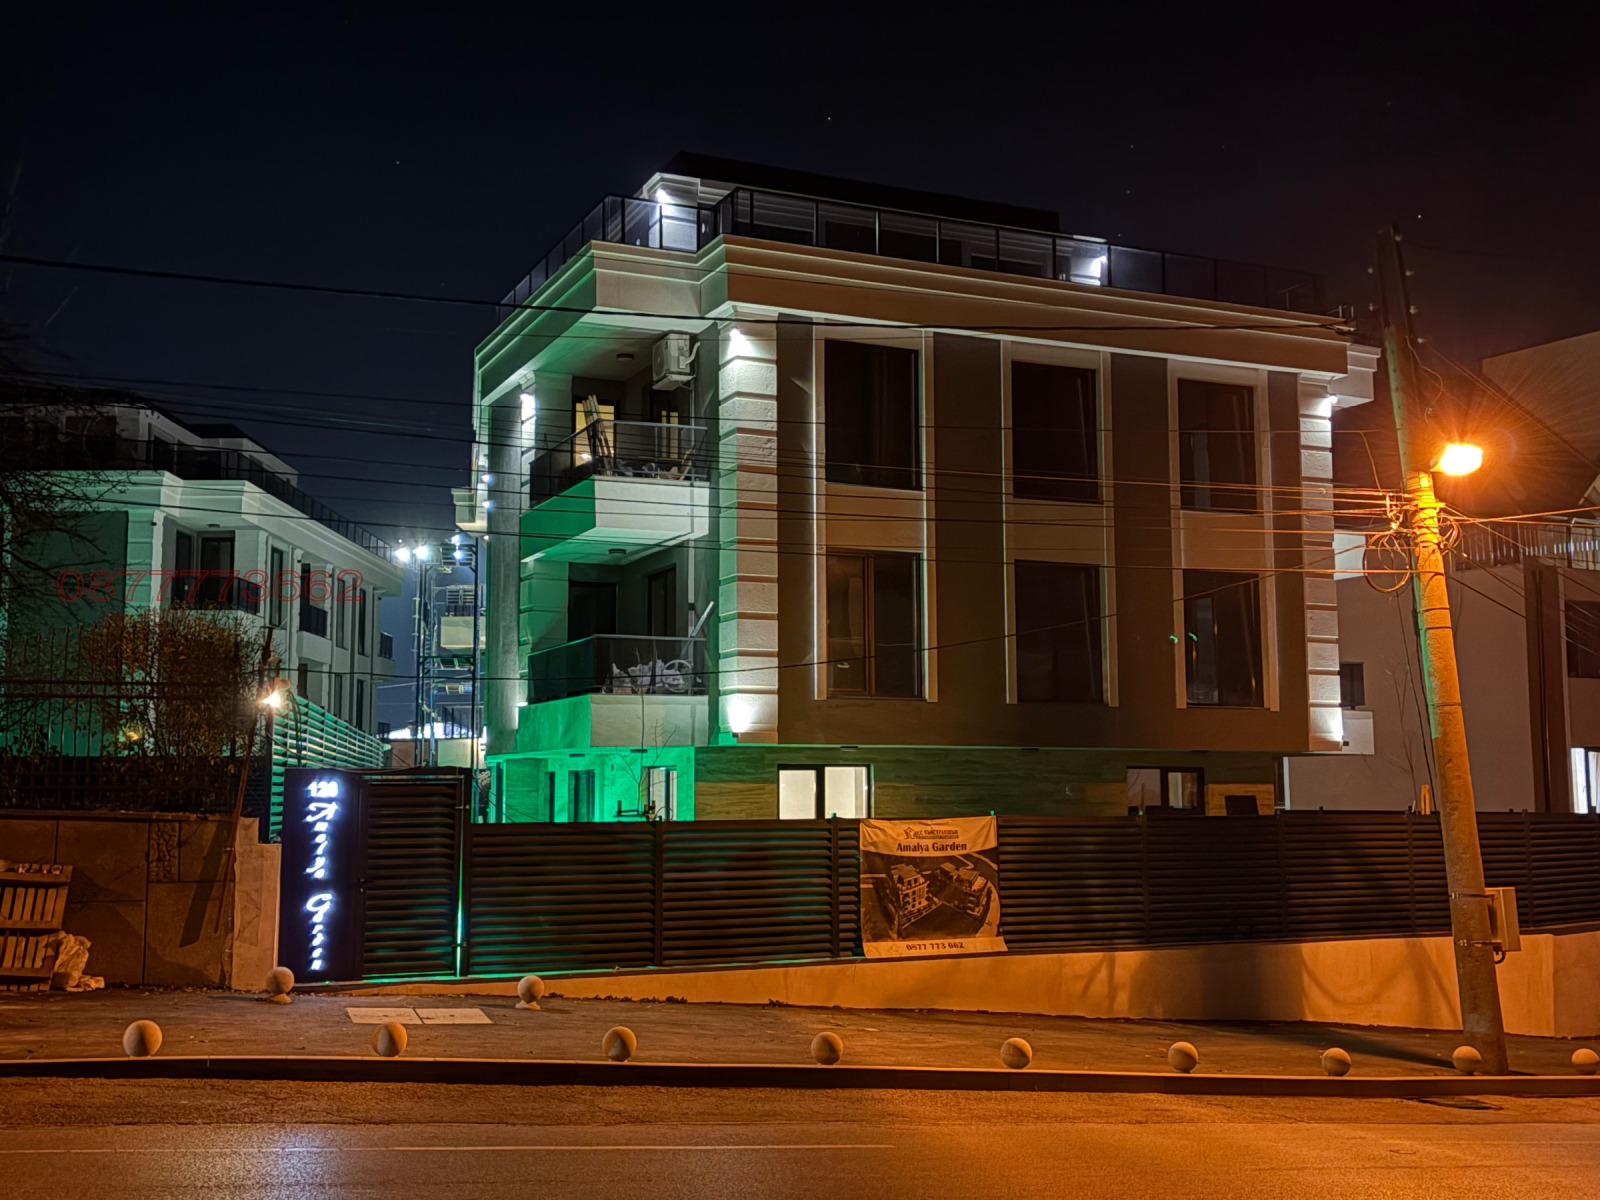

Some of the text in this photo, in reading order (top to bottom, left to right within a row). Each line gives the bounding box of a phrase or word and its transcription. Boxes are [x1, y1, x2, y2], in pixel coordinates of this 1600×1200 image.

[896, 842, 967, 854] Amalya Garden
[906, 941, 964, 951] 0877 773 662
